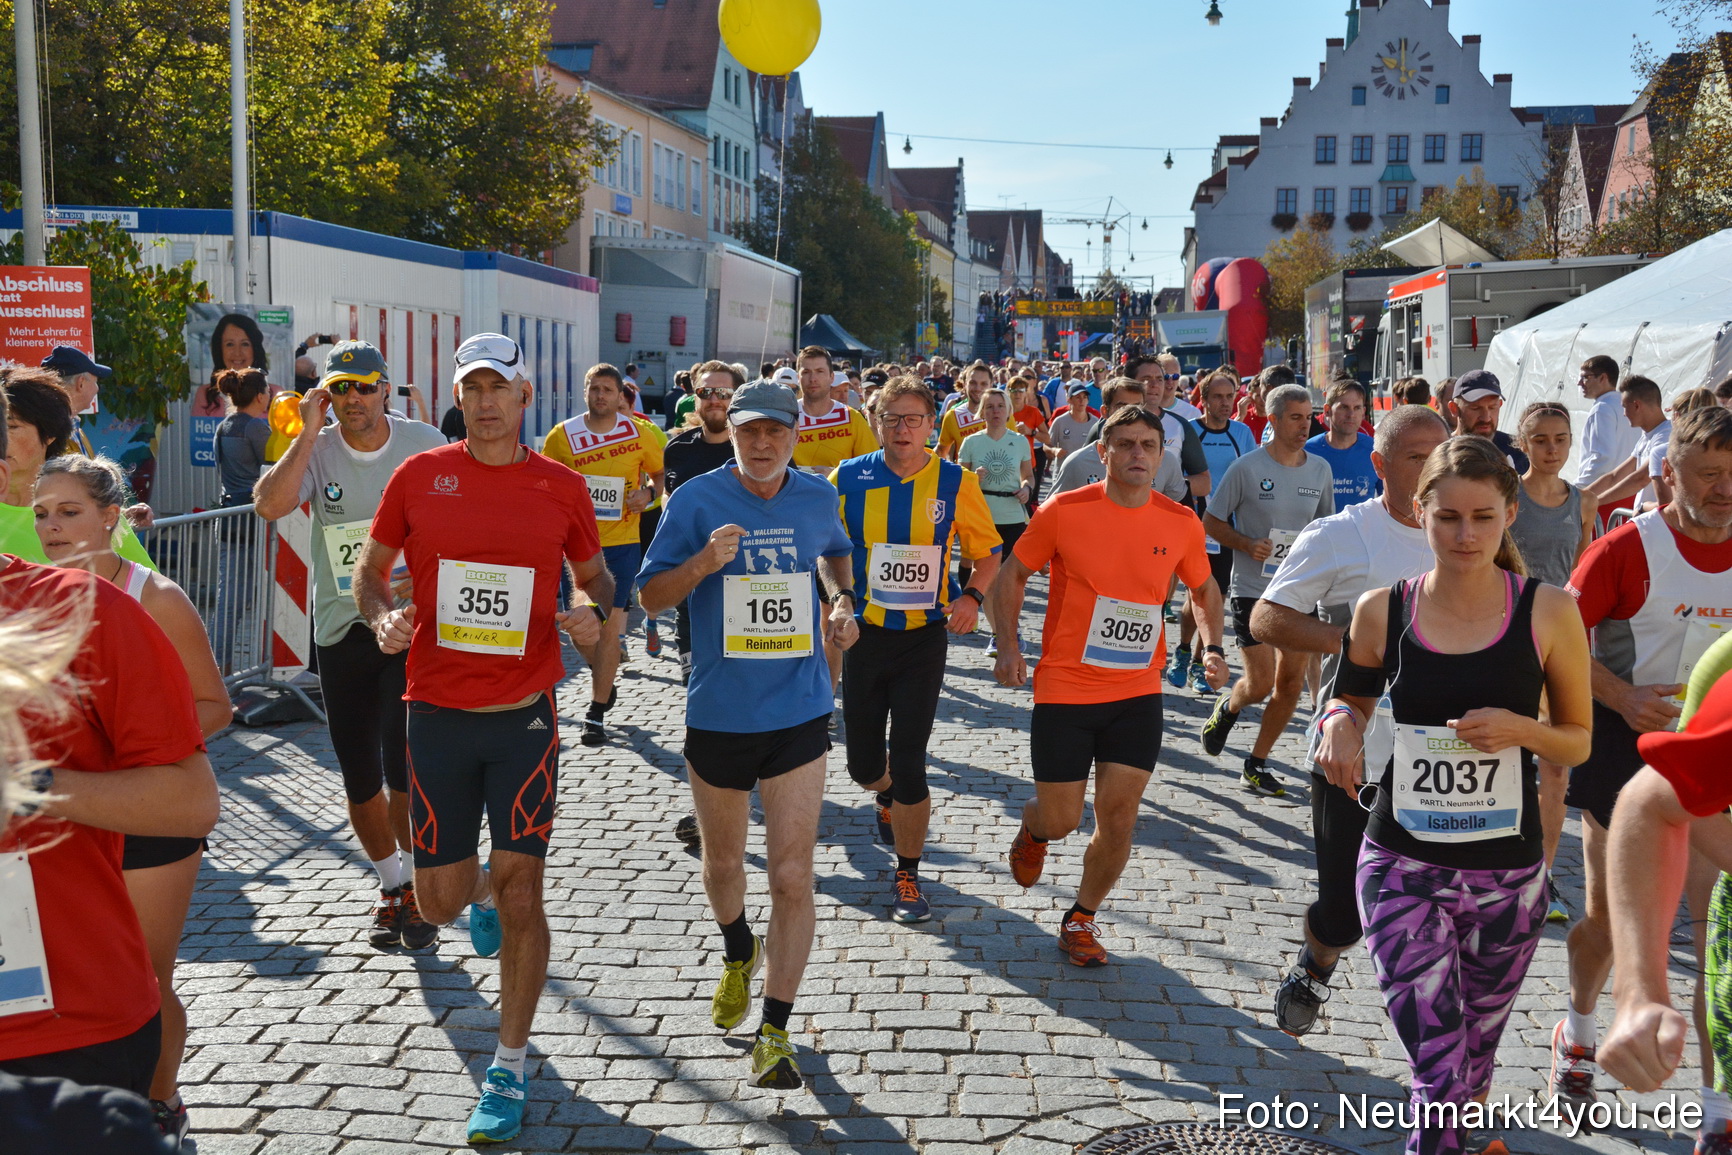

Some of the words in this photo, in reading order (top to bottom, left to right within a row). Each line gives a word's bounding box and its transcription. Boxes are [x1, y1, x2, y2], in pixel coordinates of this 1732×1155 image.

[1047, 303, 1081, 312] START
[9, 327, 35, 336] Mehr
[38, 327, 68, 336] Lehrer
[70, 327, 82, 336] für
[5, 338, 44, 347] kleinere
[46, 338, 83, 347] Klassen.
[195, 420, 215, 433] Hel
[797, 434, 813, 444] AX
[818, 428, 852, 441] BÖGL
[574, 452, 606, 468] MAX
[609, 442, 643, 459] BÖGL
[1298, 487, 1321, 497] BOCK
[324, 503, 345, 512] PARTL
[346, 526, 370, 537] BOC
[753, 528, 795, 537] WALLENSTEIN
[742, 537, 793, 547] HALBMARATHON
[340, 543, 363, 565] 23
[1274, 543, 1292, 559] 23
[465, 569, 507, 582] BOCK
[880, 562, 930, 582] 3059
[750, 582, 789, 592] BOCK
[458, 587, 509, 616] 355
[746, 598, 793, 624] 165
[1116, 605, 1149, 618] BOCK
[1697, 607, 1732, 618] KLE
[454, 616, 474, 624] PARTL
[475, 619, 503, 627] Neumarkt
[453, 626, 499, 644] RAINER
[1101, 617, 1153, 642] 3058
[746, 638, 793, 650] Reinhard
[1412, 758, 1500, 795] 2037
[1420, 798, 1445, 807] PARTL
[1428, 815, 1486, 830] Isabella
